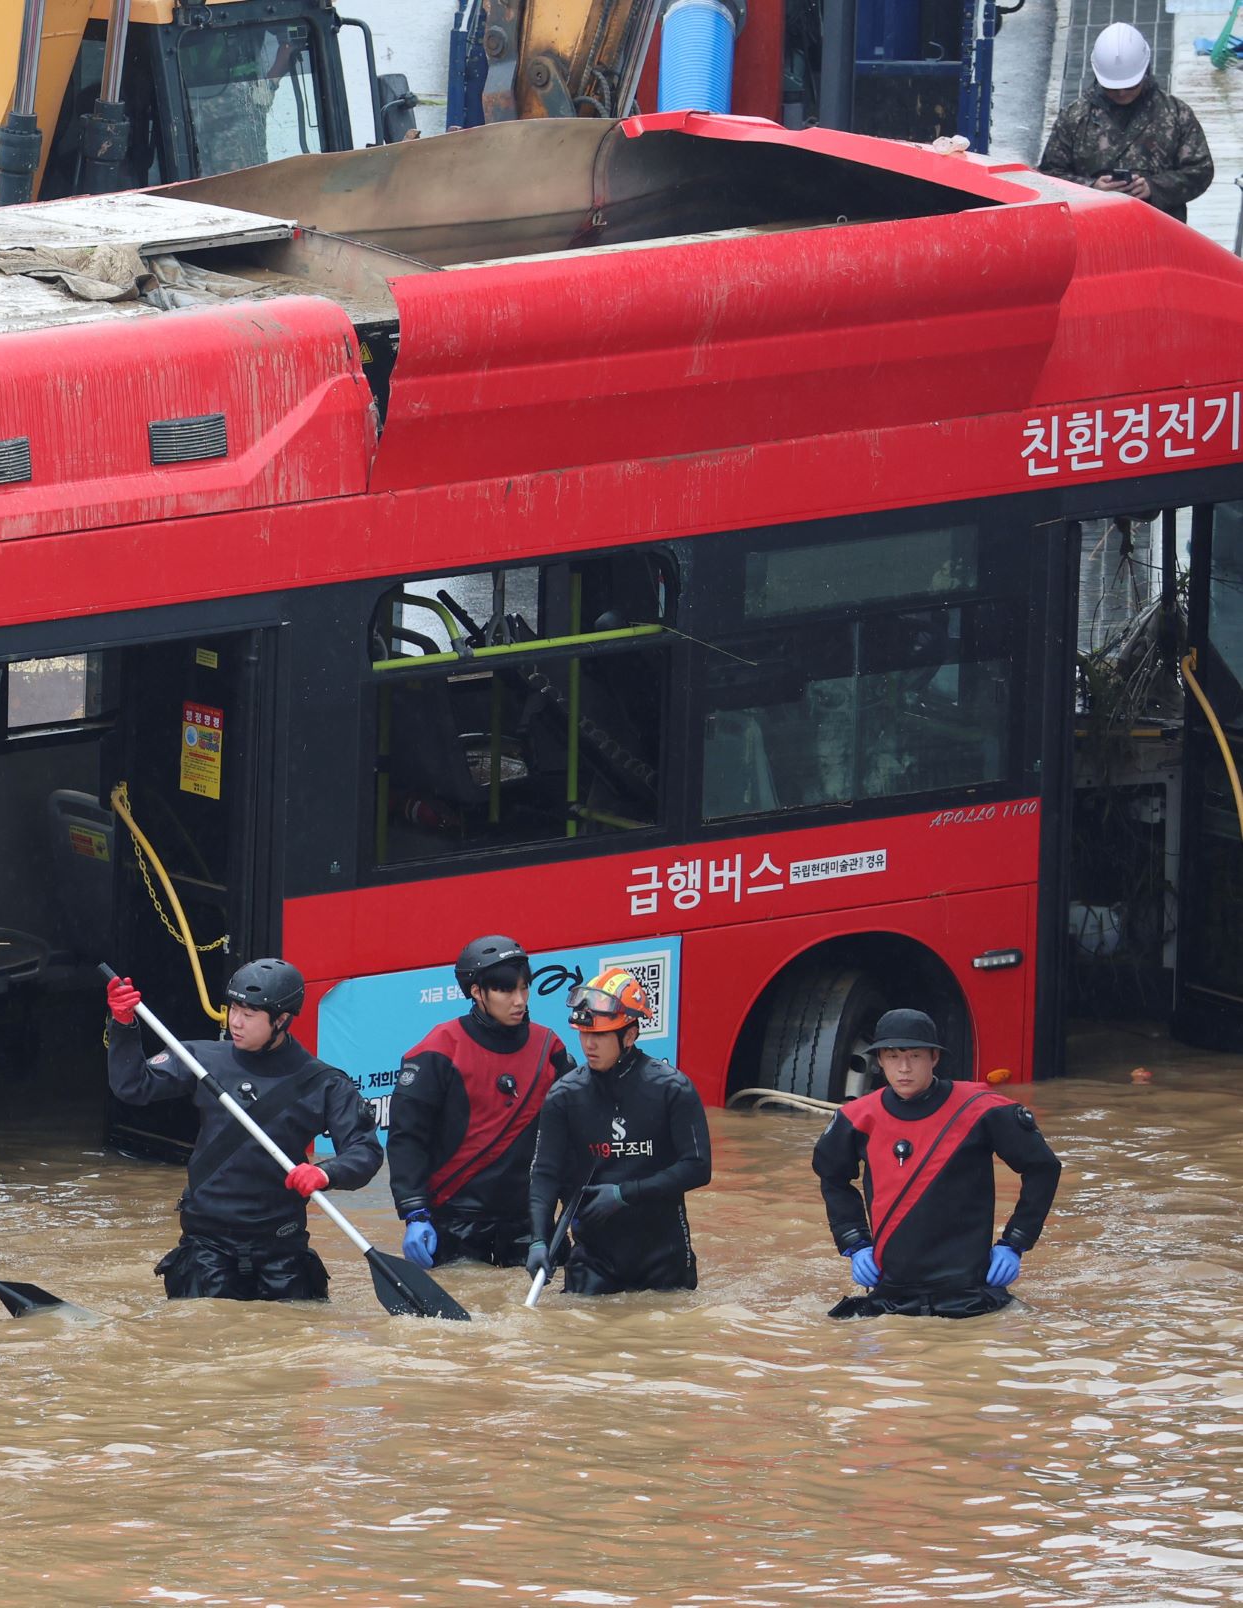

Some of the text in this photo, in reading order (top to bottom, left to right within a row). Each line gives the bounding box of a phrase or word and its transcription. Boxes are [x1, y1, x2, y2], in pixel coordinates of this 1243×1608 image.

[1020, 391, 1241, 477] 친환경전기
[929, 800, 1038, 828] APOLLO 1100
[791, 857, 858, 879] 국립현대미술관
[866, 854, 885, 869] 경유
[626, 852, 784, 916] 급행버스
[420, 987, 444, 1003] 지금
[587, 1139, 654, 1159] 119구조대
